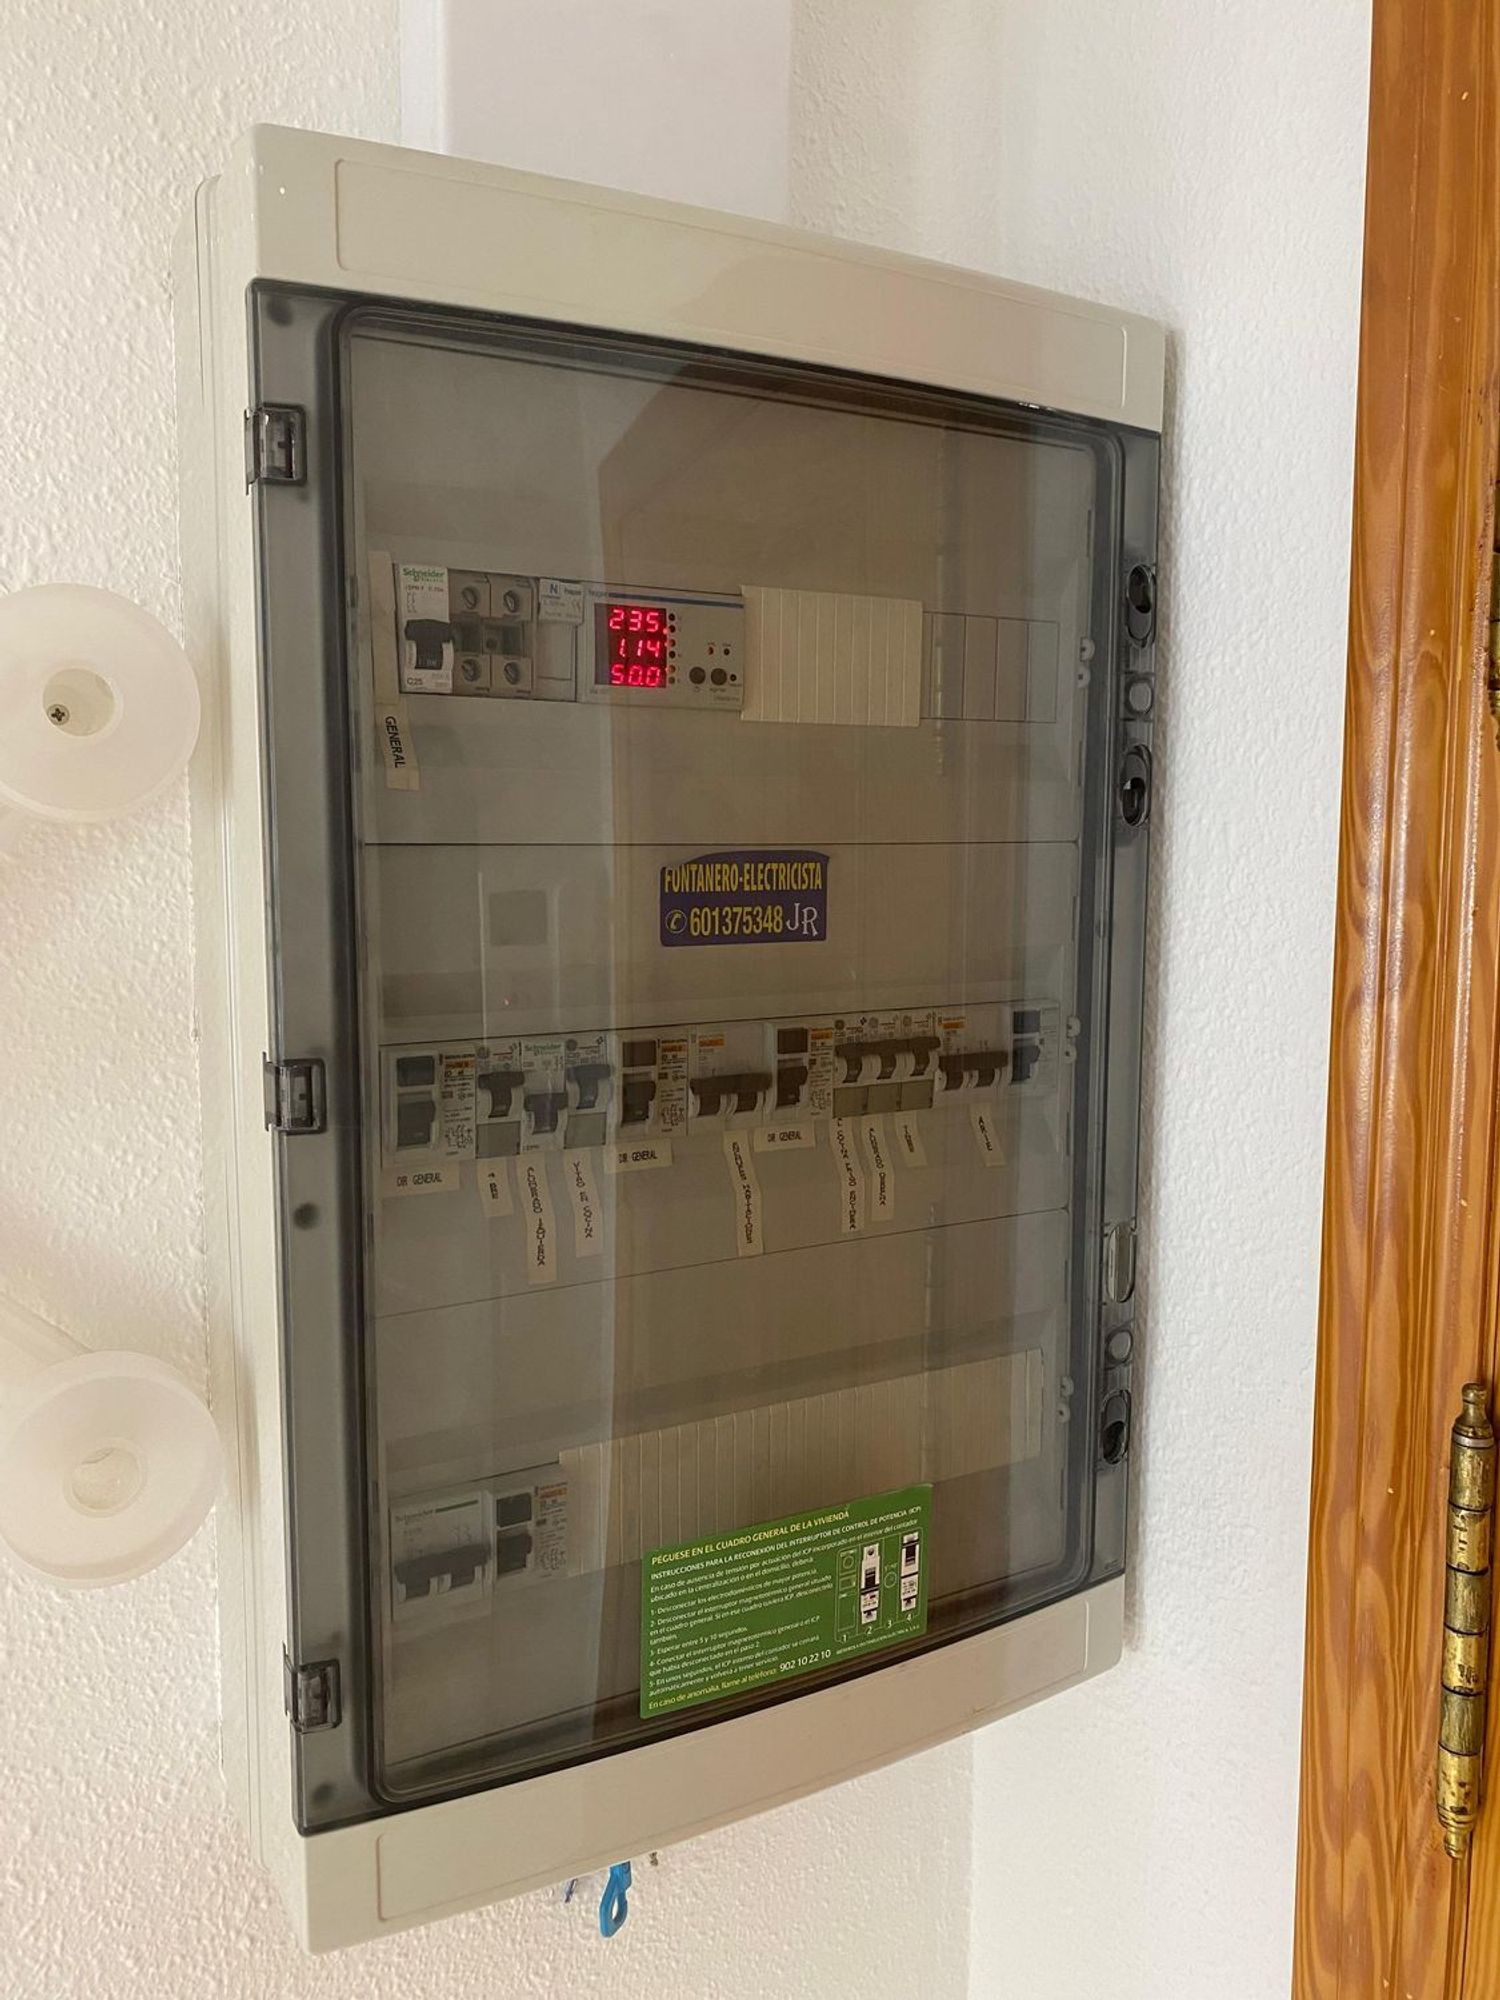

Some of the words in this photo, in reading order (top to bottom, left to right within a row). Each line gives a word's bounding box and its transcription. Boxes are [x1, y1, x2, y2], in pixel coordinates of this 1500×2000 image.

[608, 608, 660, 633] 235
[610, 663, 662, 687] 50.0
[385, 716, 406, 768] GENERAL
[690, 904, 783, 936] 601375348
[786, 902, 819, 936] JR
[650, 1561, 704, 1580] INSTRUCCIONES
[705, 1556, 722, 1566] PARA
[724, 1553, 732, 1562] LA
[776, 1539, 787, 1548] DEL
[788, 1528, 831, 1545] INTERRUPTOR
[832, 1526, 840, 1534] DE
[841, 1519, 868, 1531] CONTROL
[869, 1516, 877, 1524] DE
[878, 1509, 906, 1522] POTENCIA
[692, 1545, 703, 1556] EN
[704, 1542, 715, 1553] EL
[715, 1534, 750, 1550] CUADRO
[752, 1525, 788, 1541] GENERAL
[790, 1522, 800, 1532] DE
[802, 1519, 812, 1529] LA
[814, 1510, 849, 1526] VIVIENDA
[660, 1580, 675, 1591] caso
[866, 1625, 872, 1635] 2
[887, 1618, 892, 1629] 3
[842, 1633, 846, 1642] 1
[659, 1696, 675, 1707] caso
[676, 1693, 685, 1702] de
[779, 1659, 795, 1672] 902
[798, 1655, 807, 1666] 10
[808, 1652, 818, 1663] 22
[821, 1648, 831, 1659] 10
